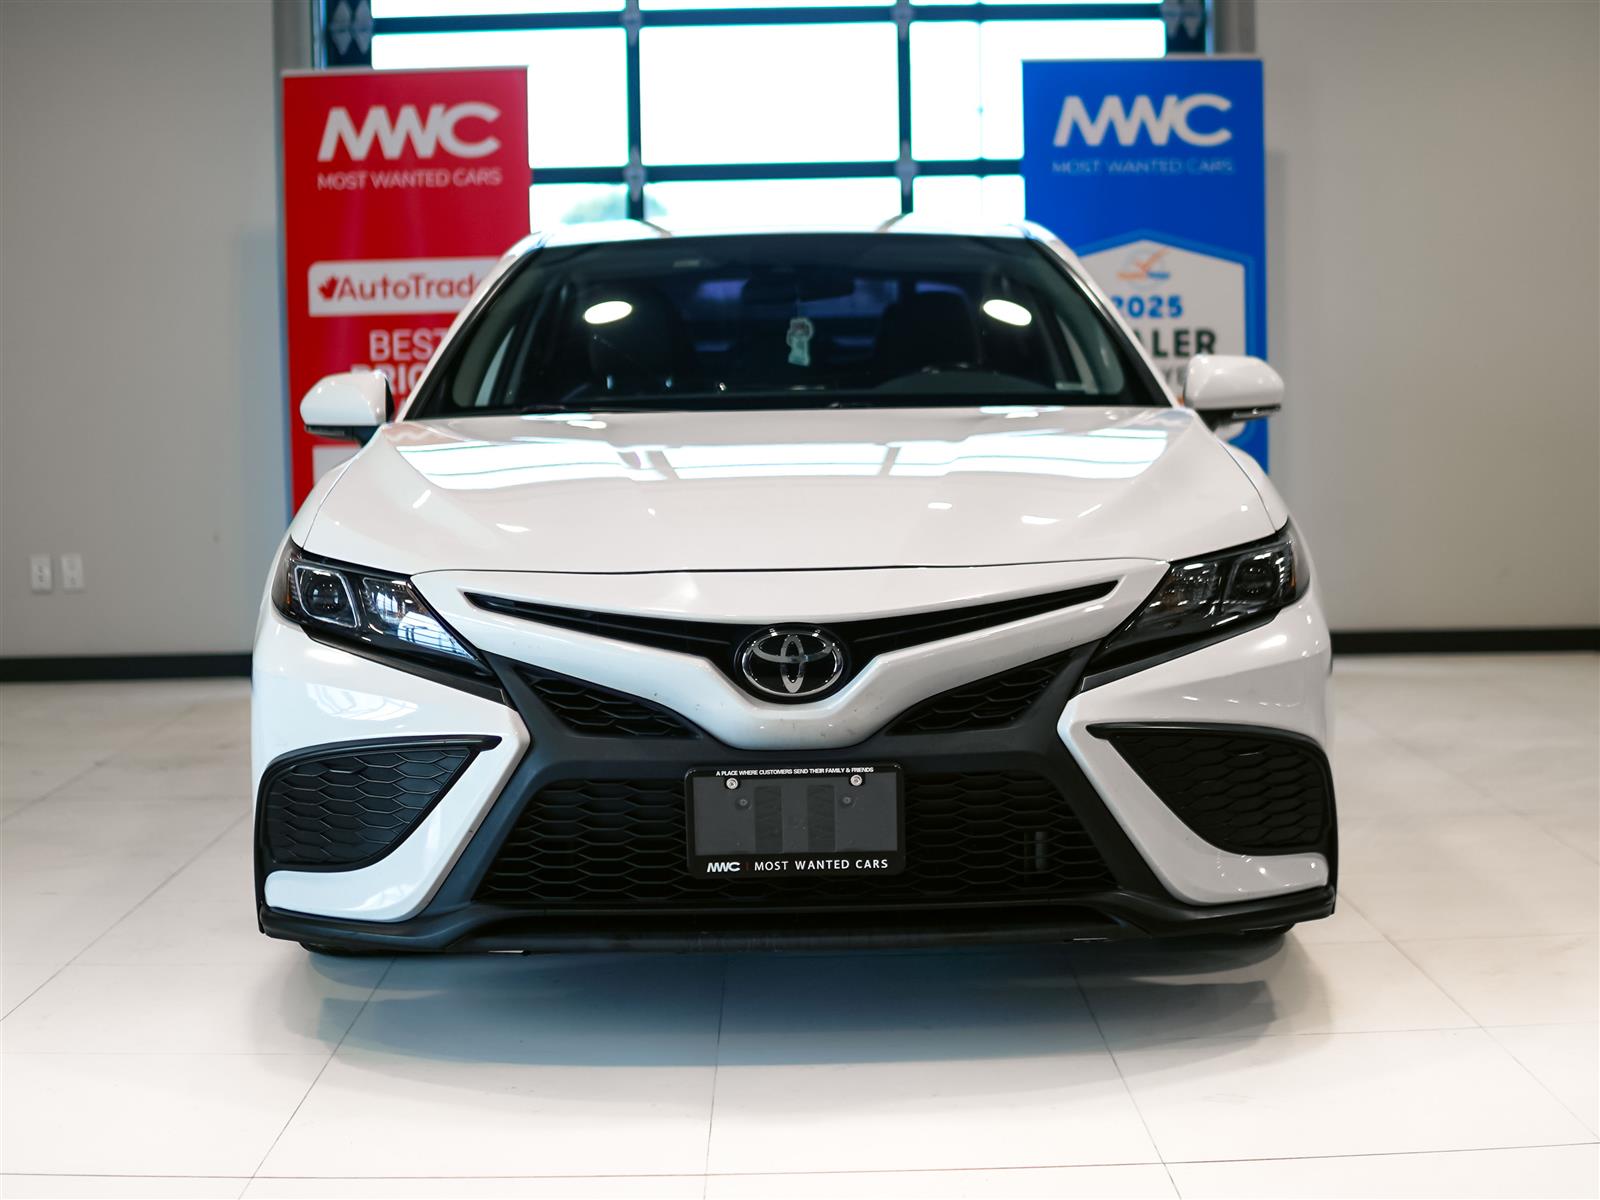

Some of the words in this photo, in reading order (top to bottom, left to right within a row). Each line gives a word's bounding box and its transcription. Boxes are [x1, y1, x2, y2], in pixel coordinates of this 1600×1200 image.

[317, 102, 501, 162] MWC
[1054, 93, 1232, 147] MWC
[317, 171, 367, 191] MOST
[370, 169, 449, 188] WANTED
[452, 167, 502, 186] CARS
[1052, 159, 1101, 175] MOST
[1107, 158, 1181, 174] WANTED
[1187, 158, 1233, 174] CARS
[337, 272, 481, 300] AutoTrad
[706, 861, 741, 873] MWC
[754, 861, 789, 871] MOST
[795, 859, 850, 870] WANTED
[855, 859, 889, 869] CARS
